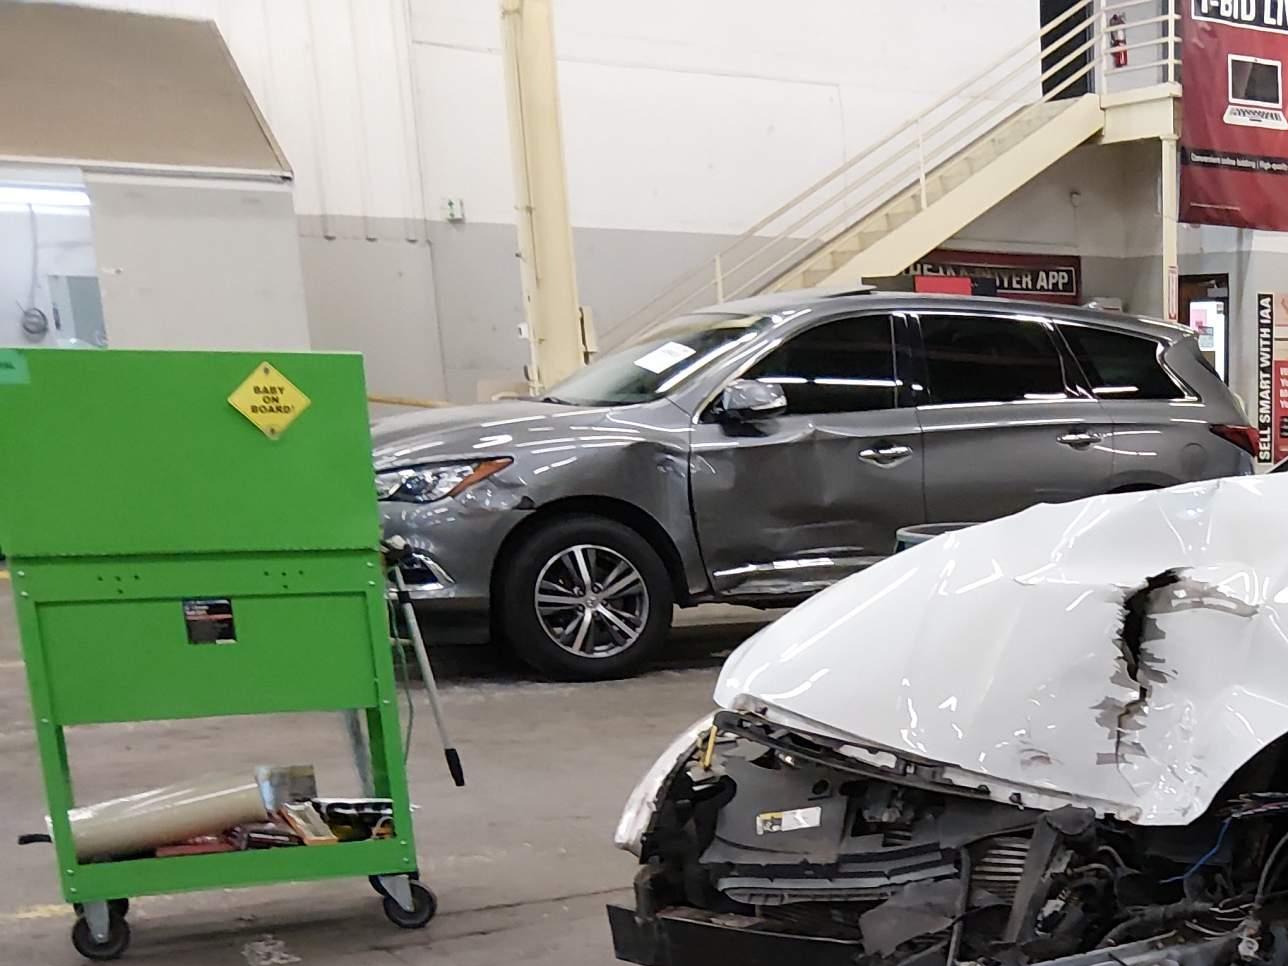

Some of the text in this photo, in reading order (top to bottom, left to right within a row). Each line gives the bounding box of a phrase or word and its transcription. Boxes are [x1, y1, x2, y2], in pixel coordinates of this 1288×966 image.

[995, 271, 1032, 290] YER
[1036, 271, 1069, 291] APP
[1259, 297, 1271, 460] SELL SMART WITH IAA
[253, 386, 284, 395] BABY
[262, 396, 279, 404] ON
